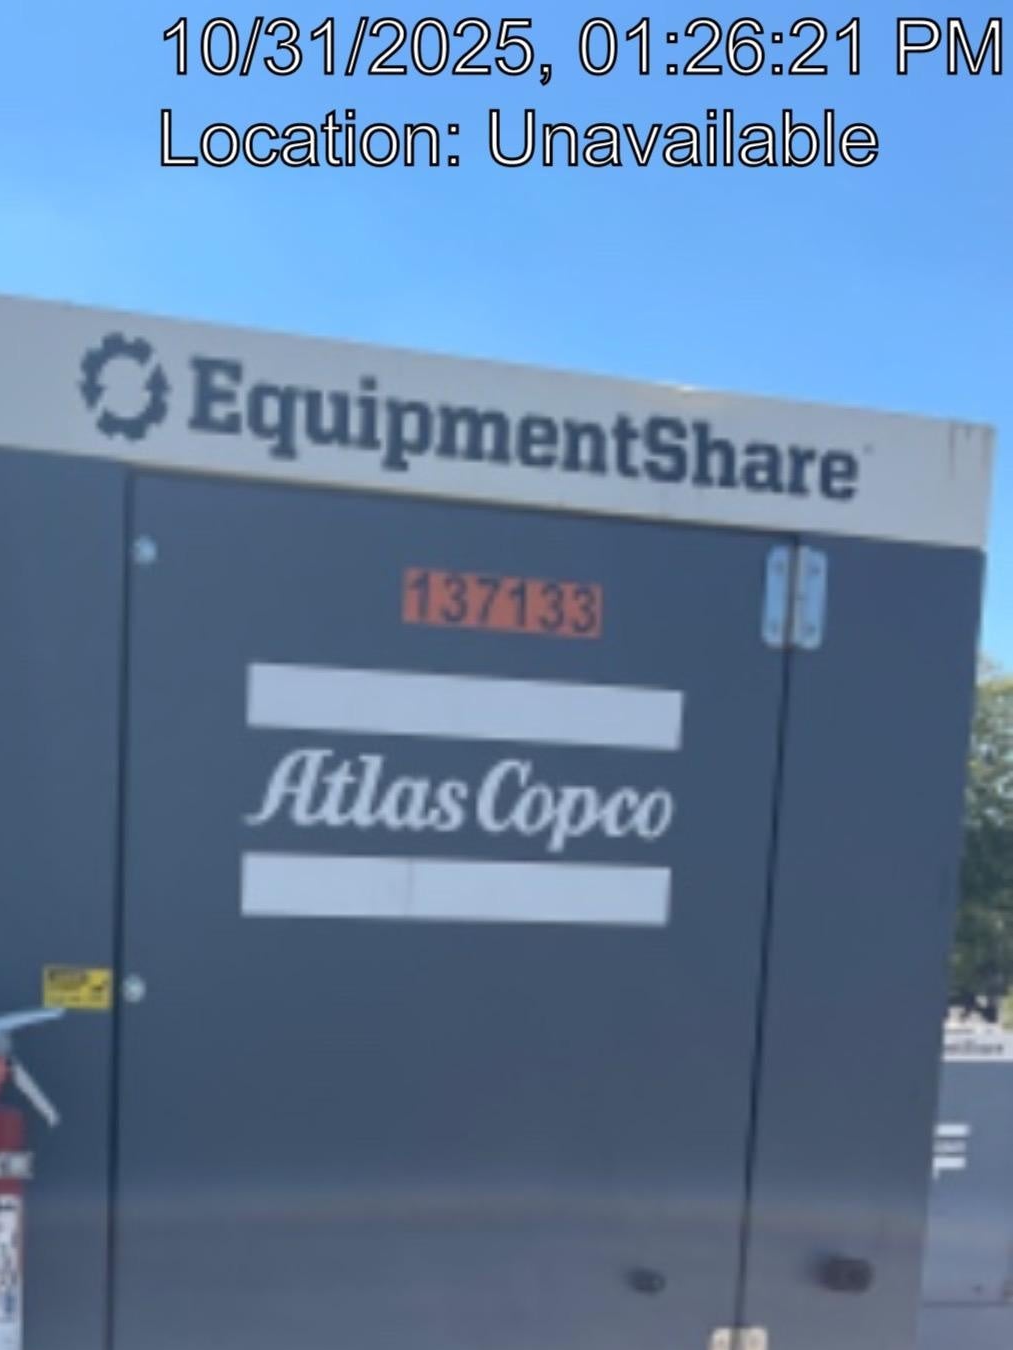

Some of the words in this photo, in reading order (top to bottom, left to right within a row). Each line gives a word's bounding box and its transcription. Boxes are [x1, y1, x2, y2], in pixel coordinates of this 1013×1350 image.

[188, 354, 859, 502] EquipmentShare
[409, 570, 599, 635] 137133
[243, 747, 468, 832] Atlas
[476, 758, 674, 853] Copco
